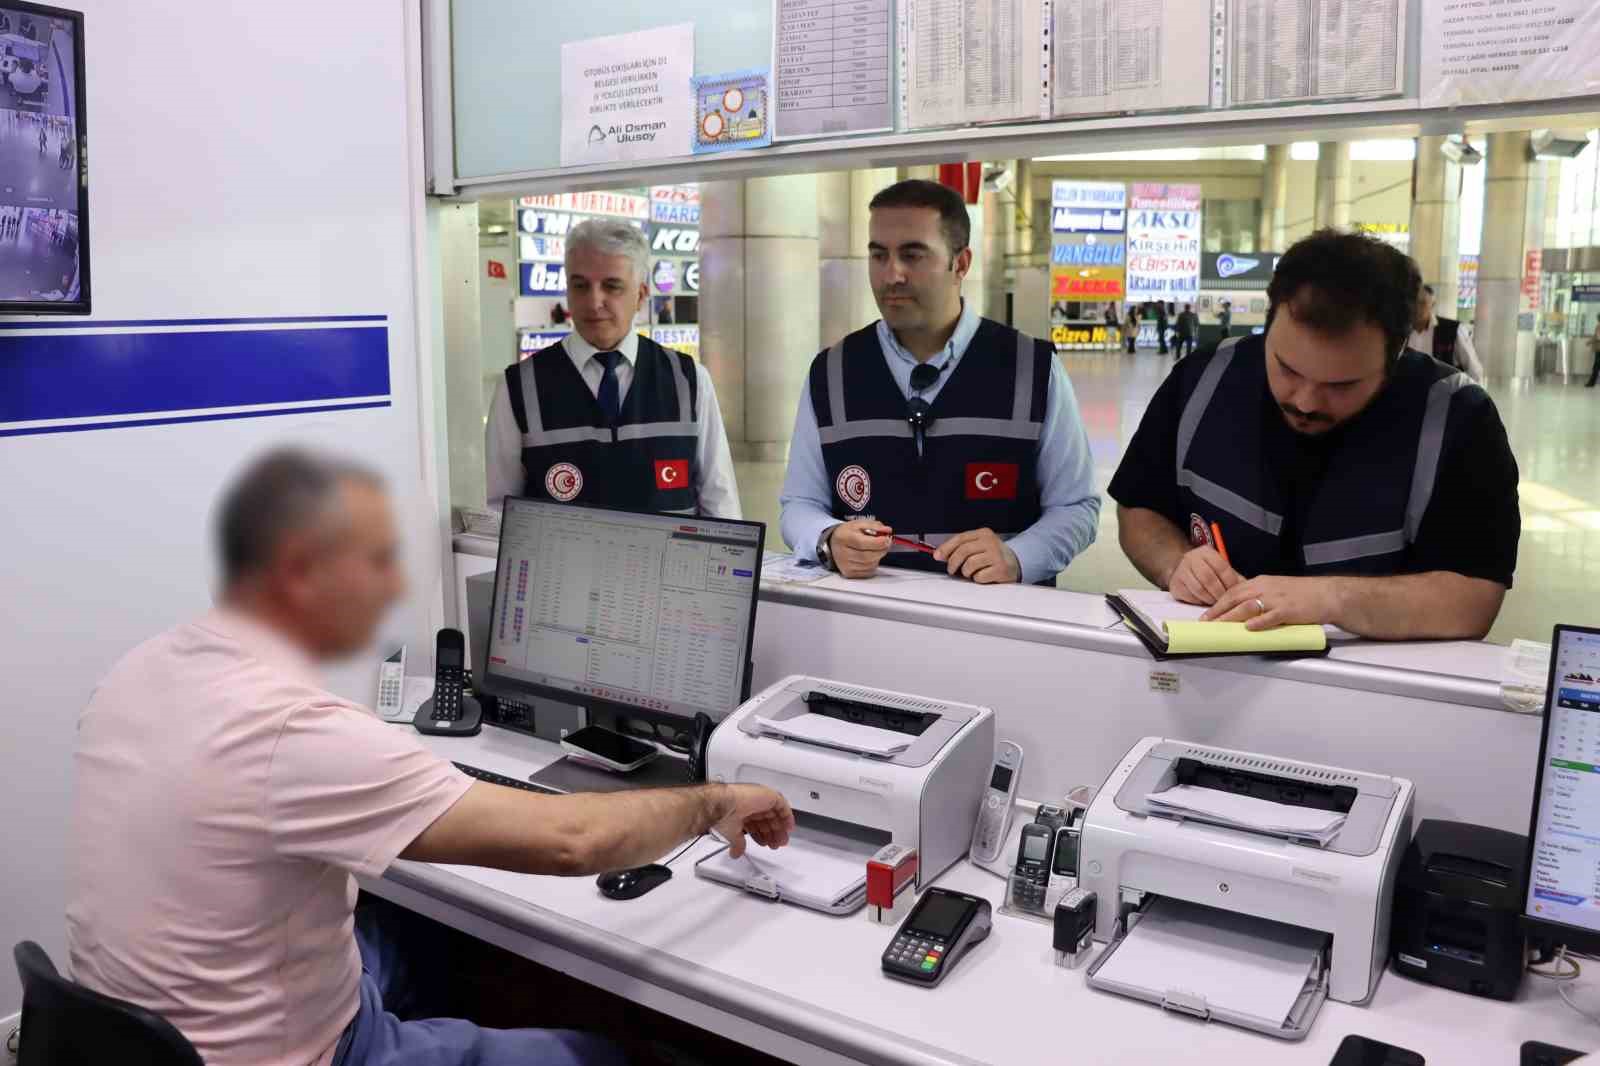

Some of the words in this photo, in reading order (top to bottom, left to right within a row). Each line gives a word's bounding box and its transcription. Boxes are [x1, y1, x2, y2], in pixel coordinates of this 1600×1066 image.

[608, 124, 621, 136] Ali
[624, 121, 667, 134] Osman
[617, 132, 656, 144] Ulusoy
[1134, 211, 1197, 229] AKSU
